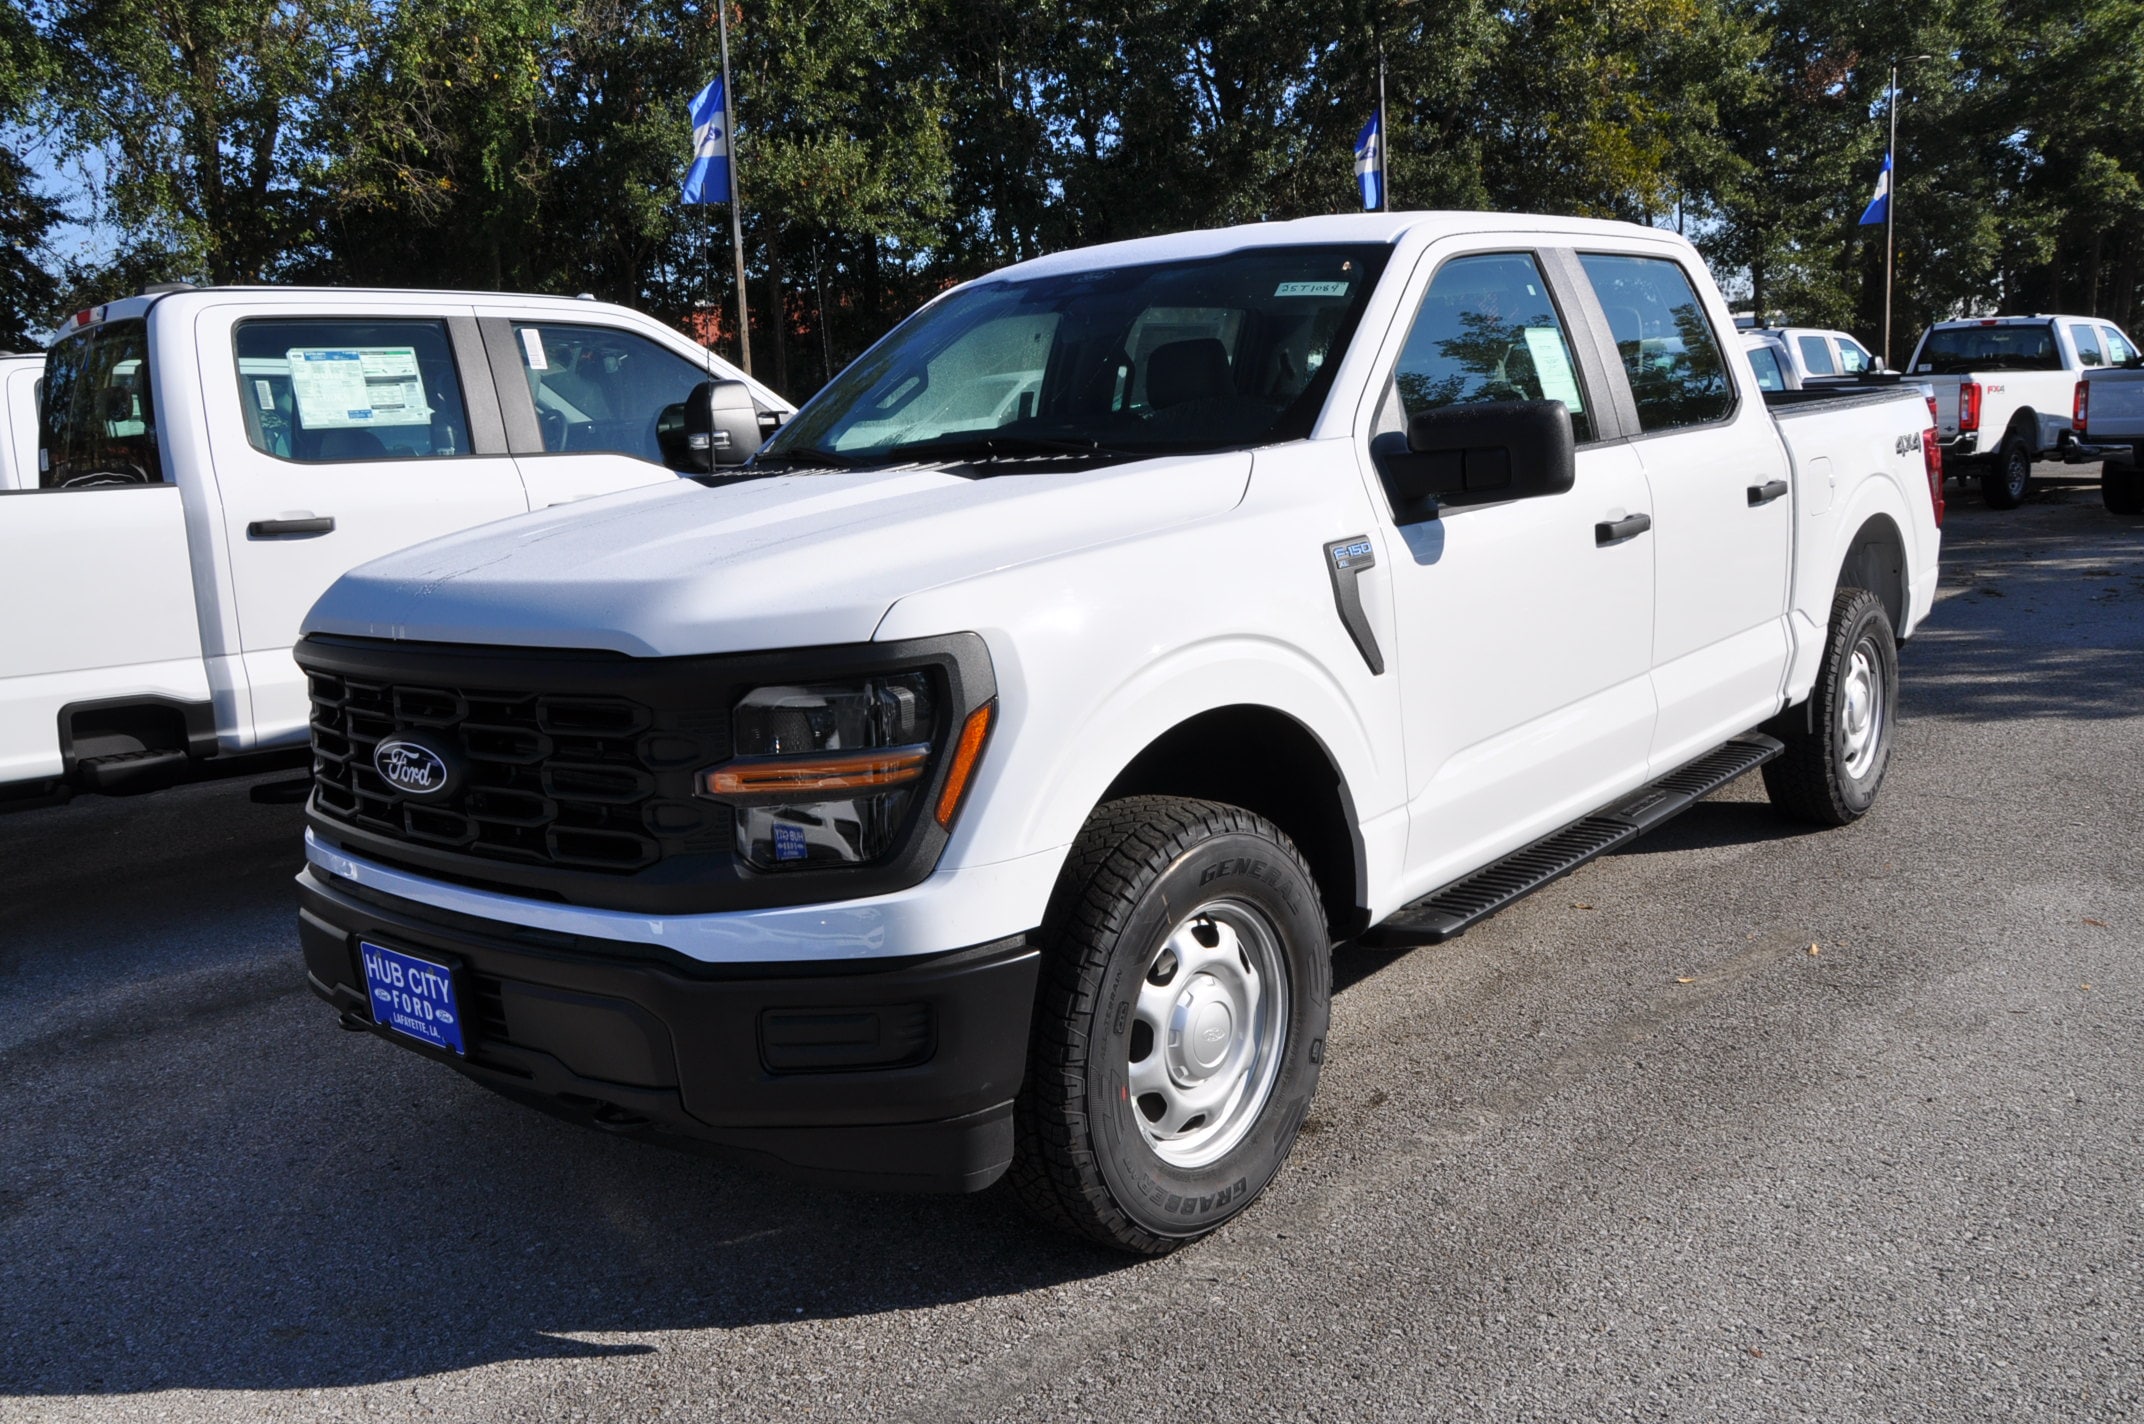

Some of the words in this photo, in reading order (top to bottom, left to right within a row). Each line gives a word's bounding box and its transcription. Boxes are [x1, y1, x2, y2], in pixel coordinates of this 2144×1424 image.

[1333, 542, 1372, 560] F-150
[388, 748, 432, 786] Ford
[1199, 857, 1299, 917] GENERAL
[366, 953, 405, 988] HUB
[408, 967, 449, 1003] CITY
[392, 989, 434, 1021] FORD
[393, 1012, 430, 1036] LAFAYETTE,
[1137, 1173, 1247, 1216] GRABBER
